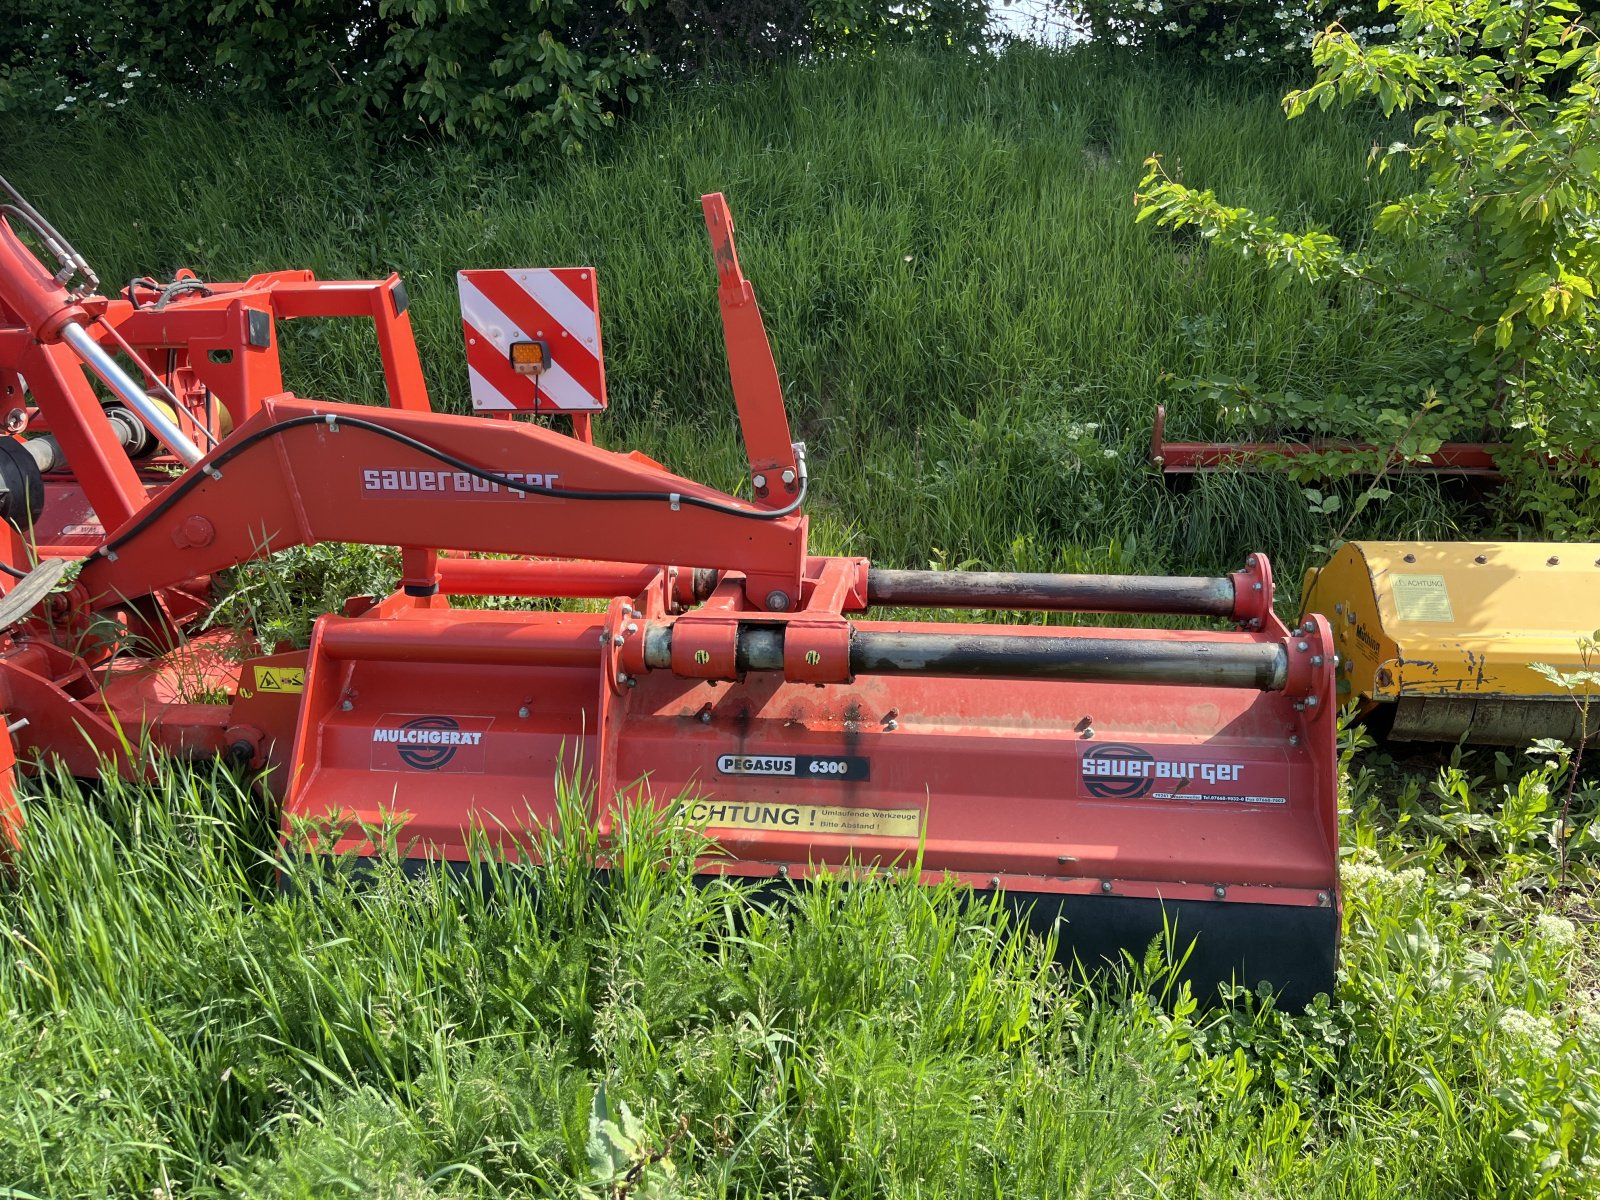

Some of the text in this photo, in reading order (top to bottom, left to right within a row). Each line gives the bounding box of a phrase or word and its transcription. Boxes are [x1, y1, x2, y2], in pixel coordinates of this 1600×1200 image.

[373, 729, 482, 745] MULCHGERÄT
[724, 759, 848, 774] PEGASUS 6300
[809, 810, 816, 826] !
[821, 810, 917, 820] Umlaufende Werkzeuge
[841, 821, 874, 830] Abstand
